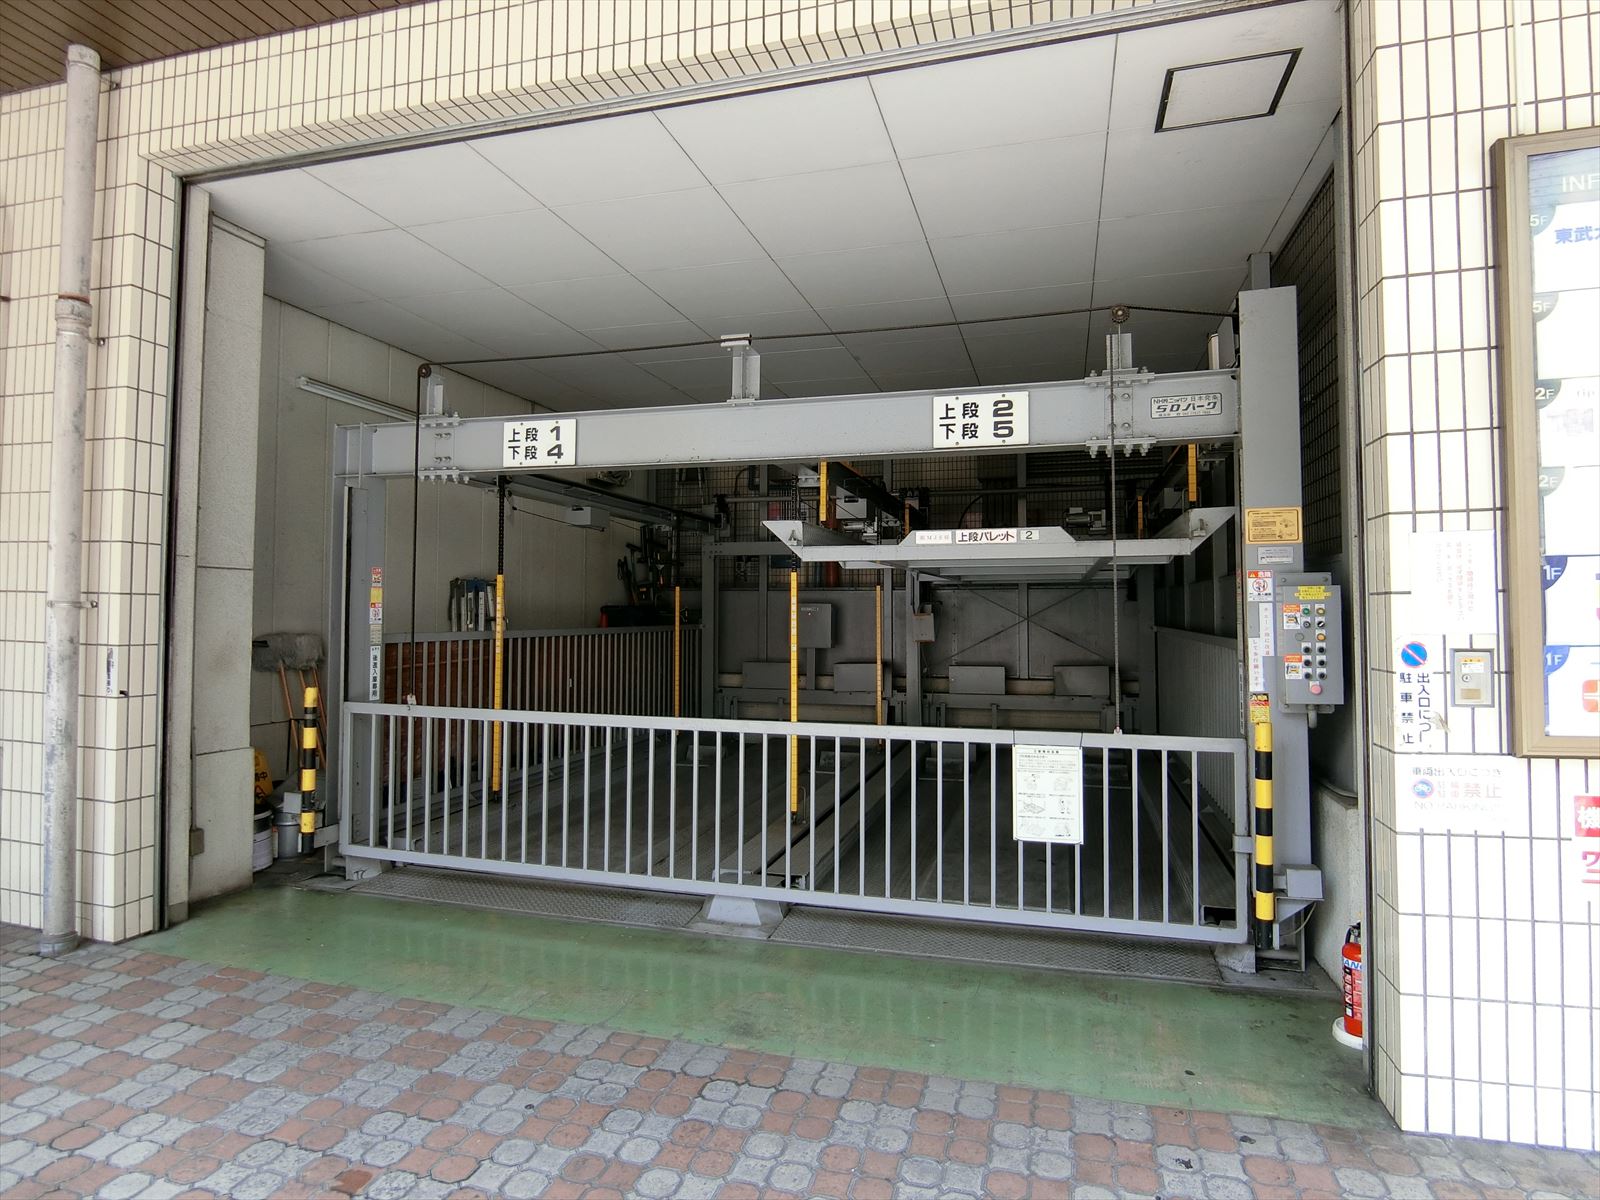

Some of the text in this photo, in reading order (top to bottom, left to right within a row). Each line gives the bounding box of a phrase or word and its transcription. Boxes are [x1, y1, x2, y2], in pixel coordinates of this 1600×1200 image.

[1530, 214, 1548, 227] 5F
[1532, 301, 1552, 314] 5F
[1535, 387, 1555, 400] 2F
[939, 399, 1014, 419] 上段 2
[508, 426, 561, 442] 上段 1
[939, 420, 1014, 440] 下段 5
[508, 443, 564, 460] 下段 4
[1538, 474, 1558, 488] 2F
[957, 530, 1015, 542] 上段パレット
[1025, 530, 1033, 540] 2
[1543, 564, 1562, 581] 1F
[1545, 652, 1563, 666] 1F
[1400, 672, 1414, 744] 駐車禁止
